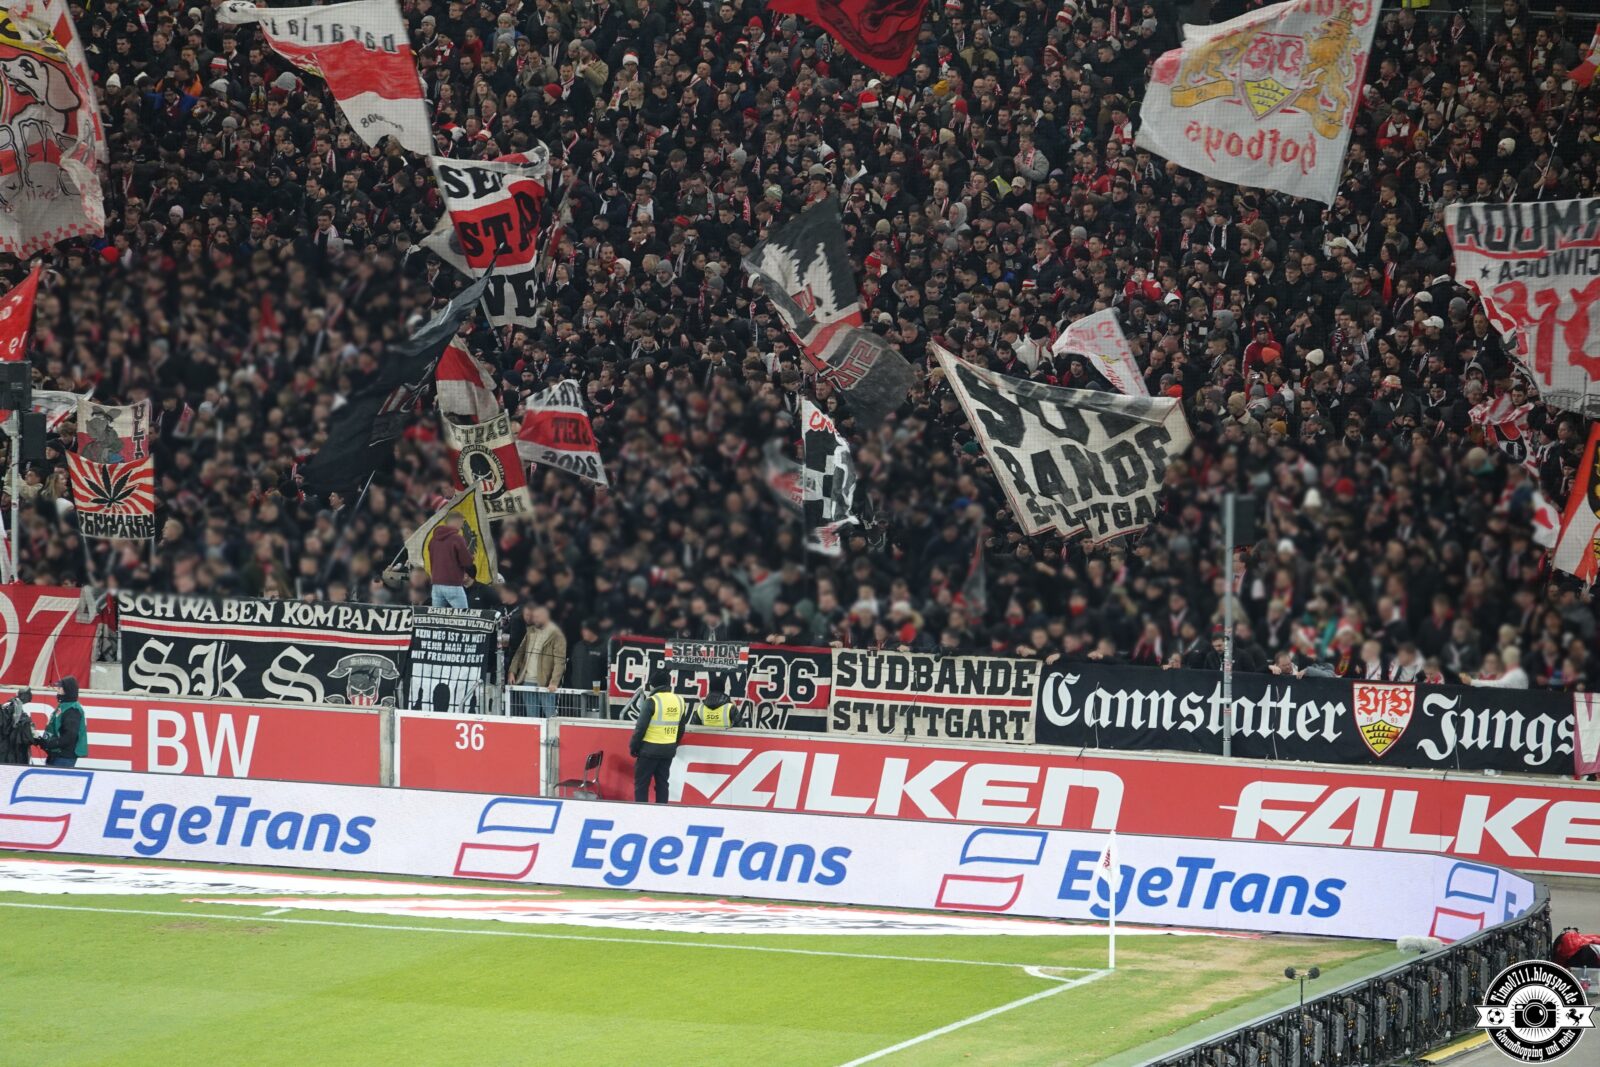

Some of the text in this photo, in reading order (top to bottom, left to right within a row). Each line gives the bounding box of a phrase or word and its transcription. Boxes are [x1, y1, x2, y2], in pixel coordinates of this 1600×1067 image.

[118, 589, 413, 632] SCHWABEN KOMPANIE
[467, 620, 494, 630] ULTRAS
[415, 628, 431, 638] KEIN
[432, 630, 446, 640] WEG
[448, 632, 459, 642] IST
[461, 633, 470, 642] ZU
[444, 643, 462, 653] MAN
[672, 643, 741, 658] SEKTION
[411, 650, 426, 659] MIT
[427, 651, 466, 663] FREUNDEN
[836, 650, 1037, 697] SÜDBANDE
[833, 700, 1030, 741] STUTTGART
[1042, 671, 1347, 743] Cannstatter
[455, 722, 485, 751] 36
[669, 745, 1125, 829] FALKEN
[103, 789, 377, 856] EgeTrans
[571, 818, 852, 887] EgeTrans
[1056, 850, 1347, 918] EgeTrans
